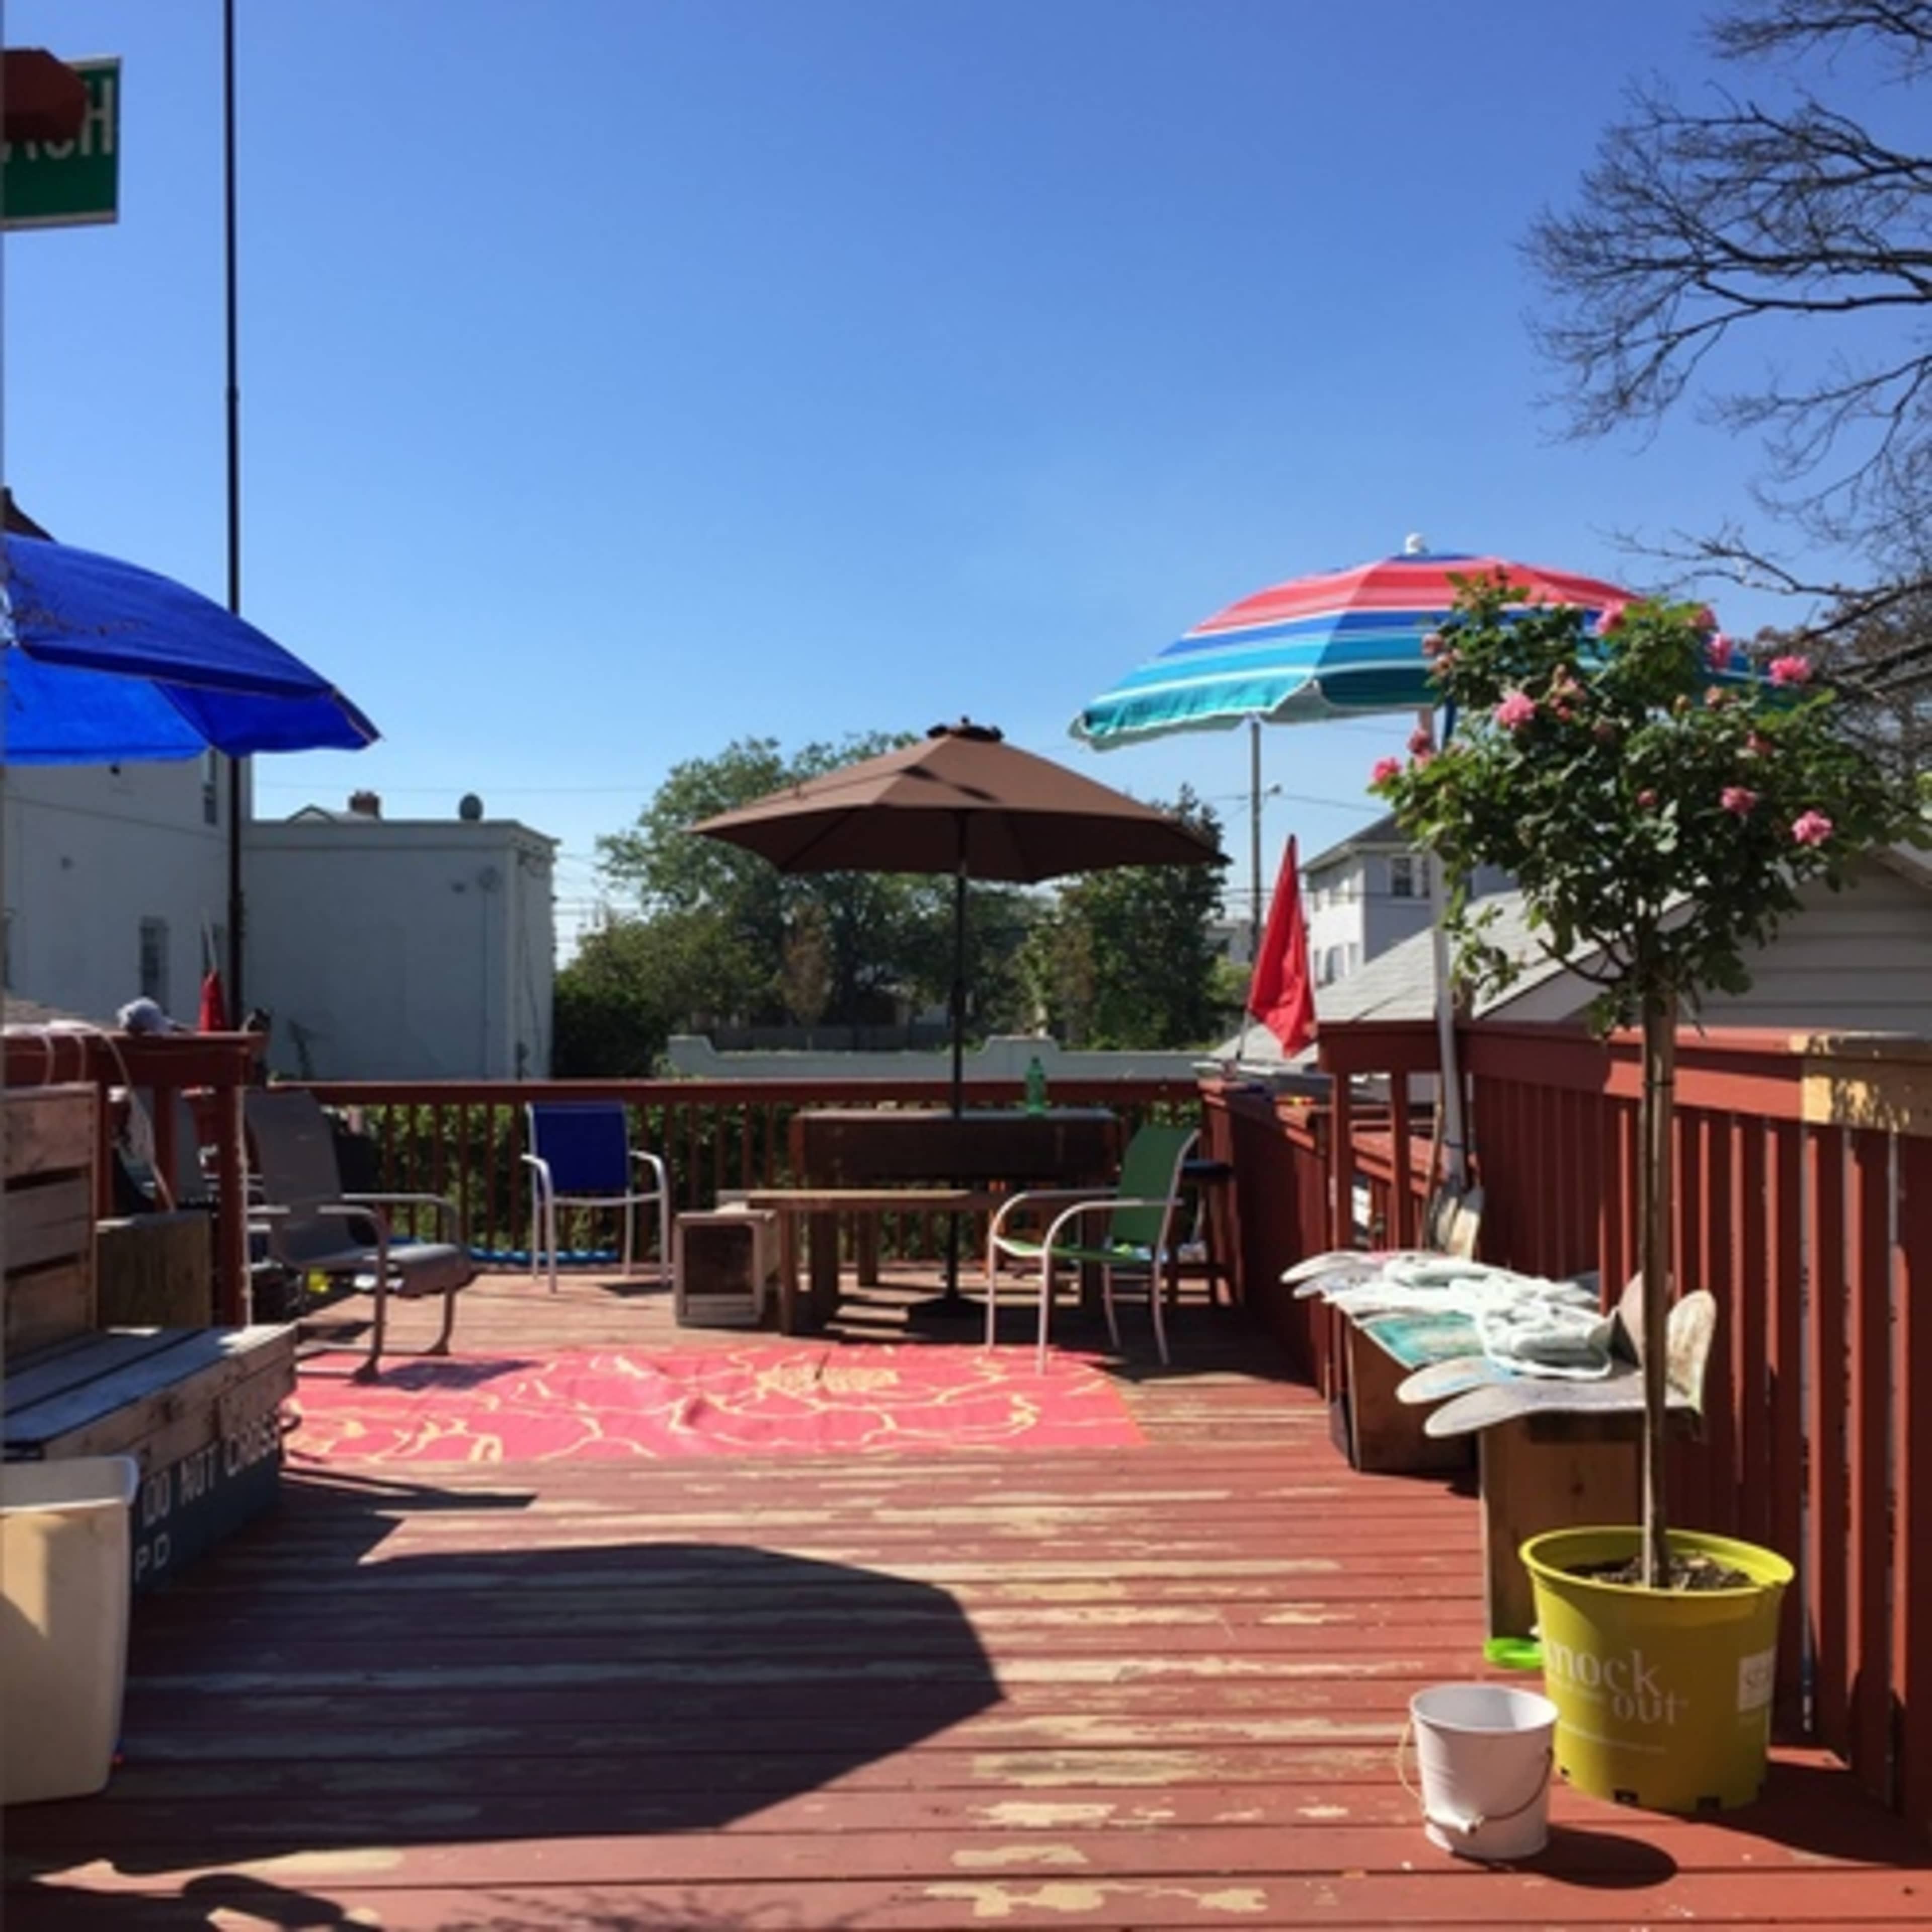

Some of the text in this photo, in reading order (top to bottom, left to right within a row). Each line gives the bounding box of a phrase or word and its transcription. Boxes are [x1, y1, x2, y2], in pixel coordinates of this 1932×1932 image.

[143, 1470, 171, 1527] DO
[180, 1442, 218, 1506] NOT
[1613, 1691, 1678, 1726] out
